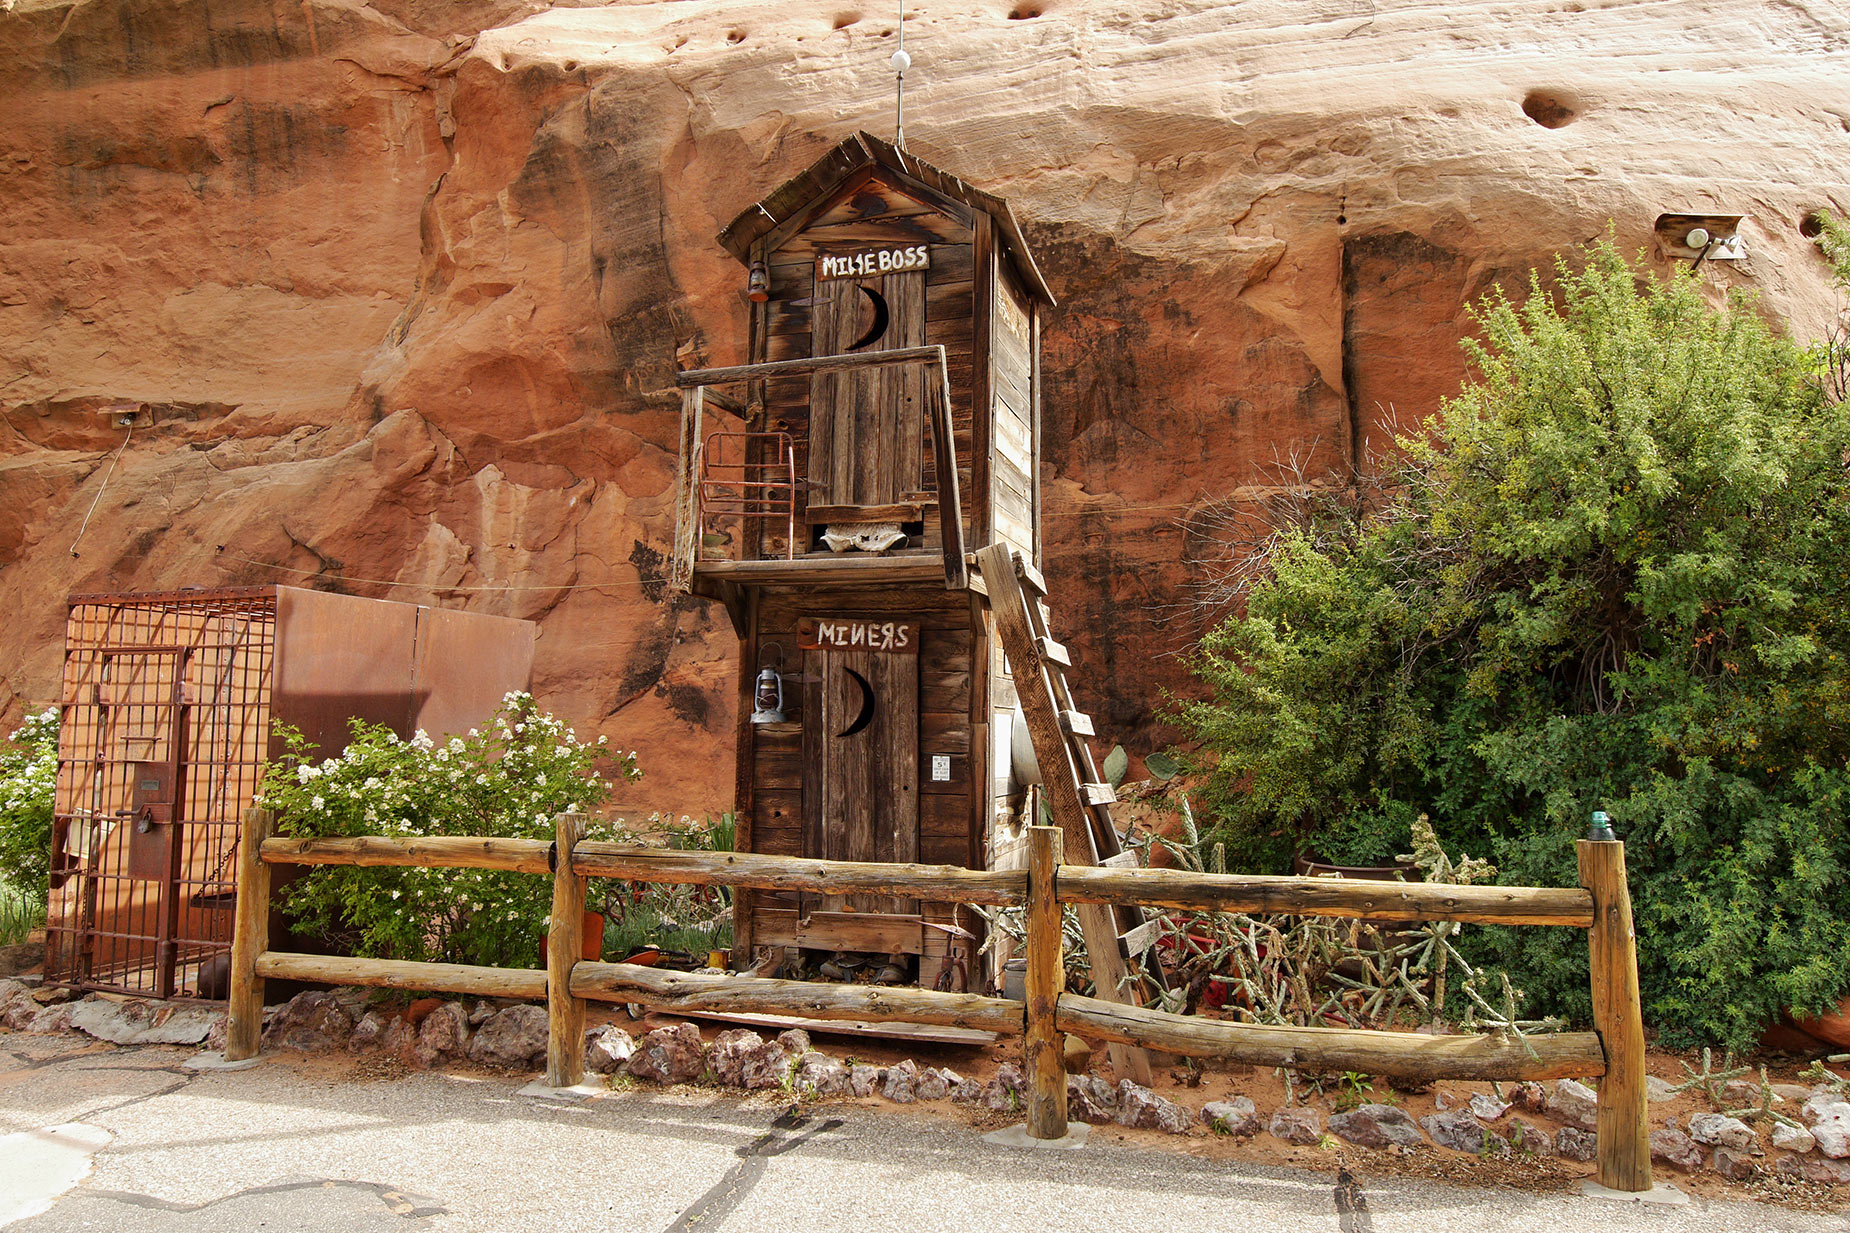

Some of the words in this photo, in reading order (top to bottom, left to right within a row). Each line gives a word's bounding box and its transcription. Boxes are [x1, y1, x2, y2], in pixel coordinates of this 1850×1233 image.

[823, 253, 876, 277] MINE
[878, 246, 927, 271] BOSS
[818, 622, 909, 650] MINERS
